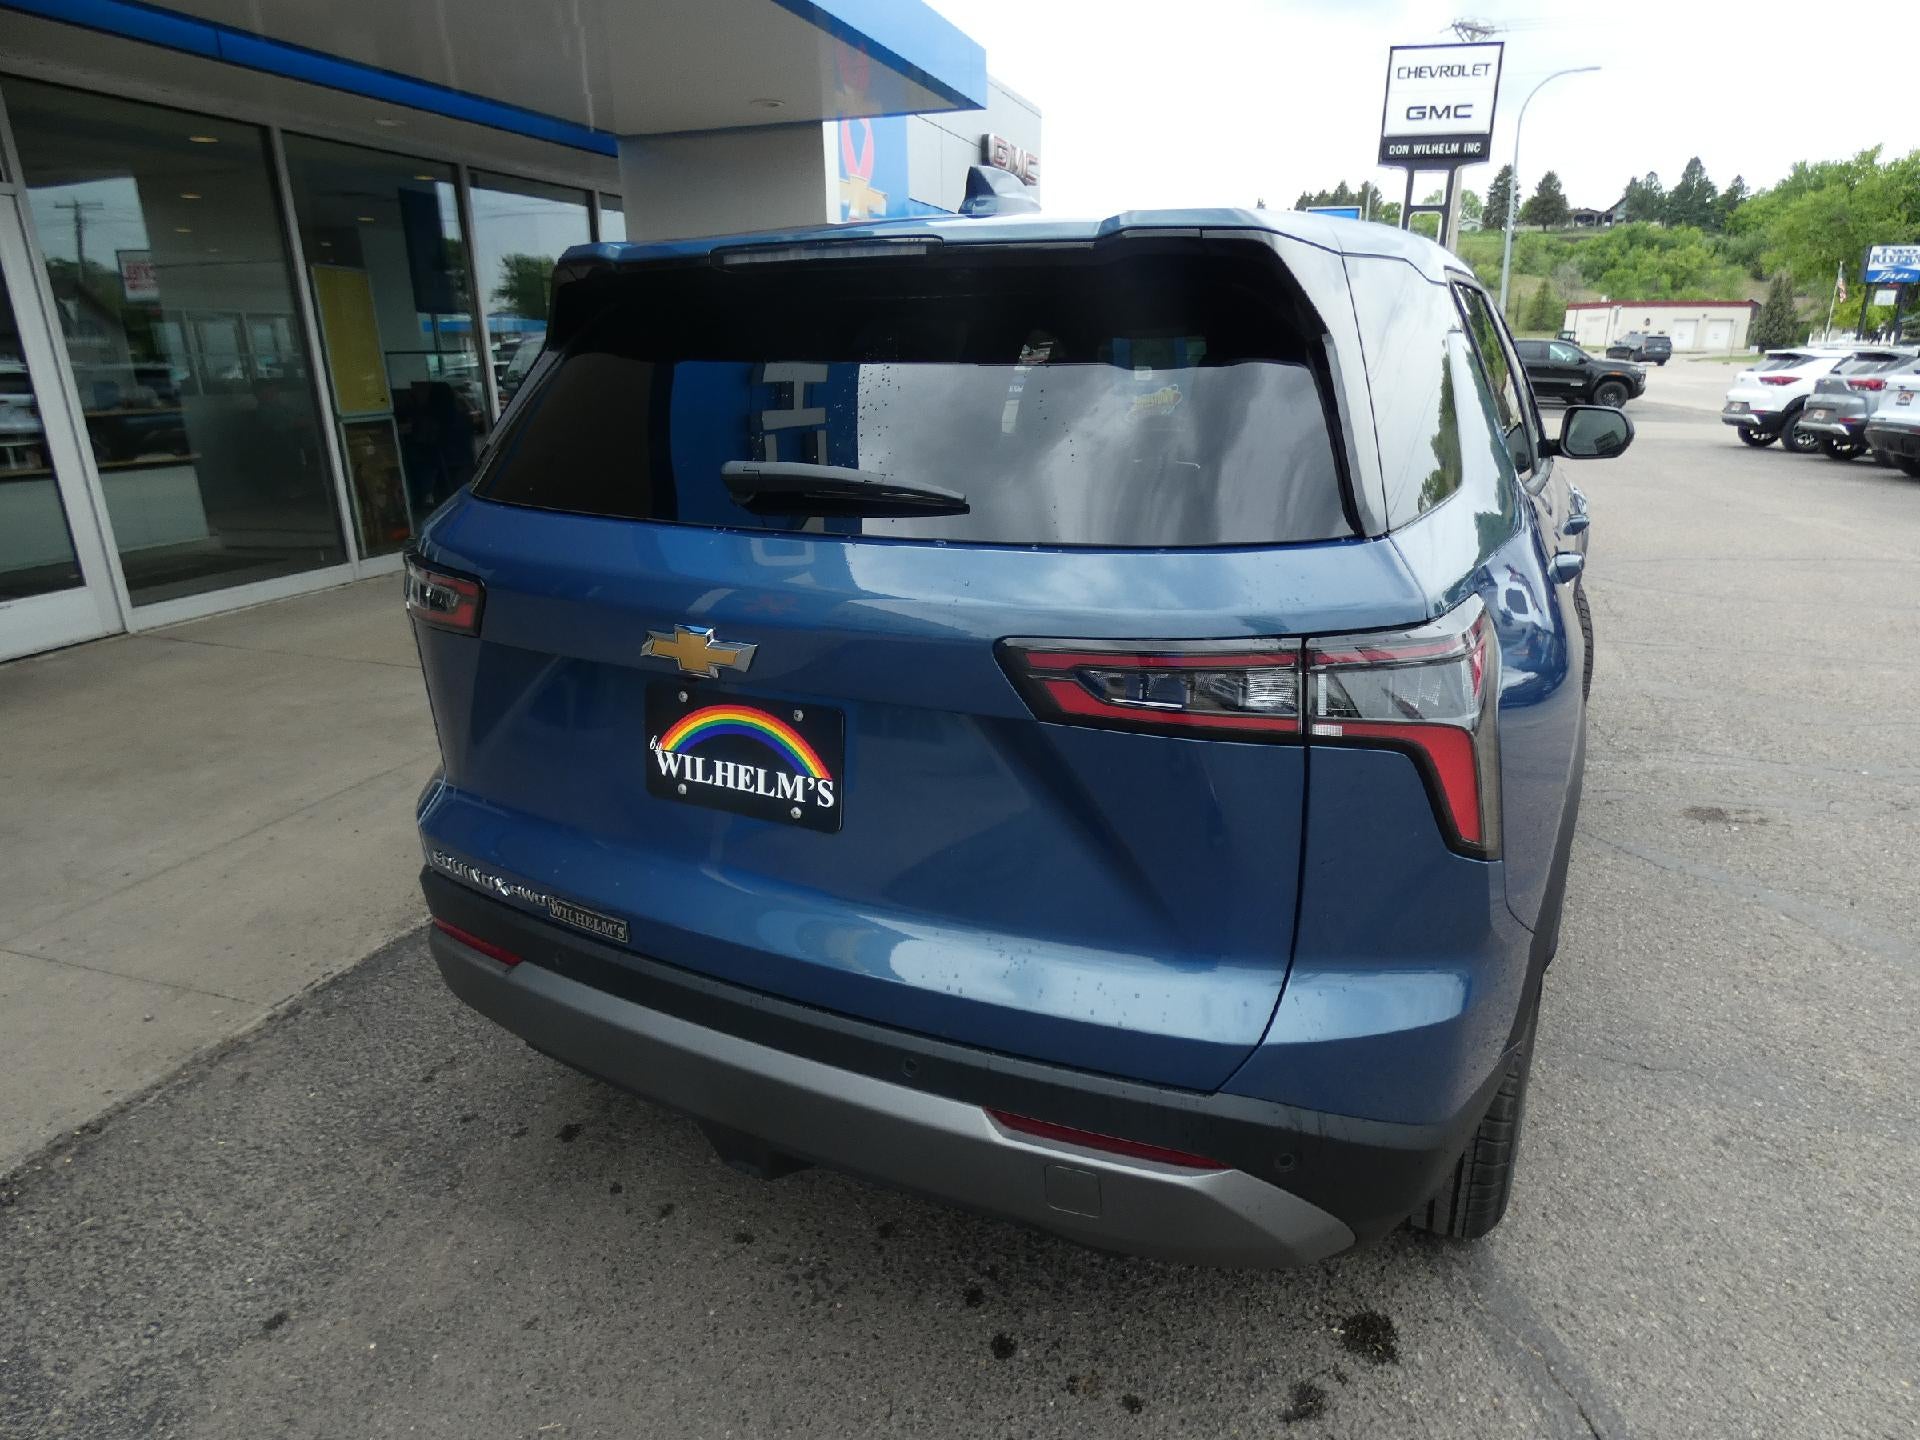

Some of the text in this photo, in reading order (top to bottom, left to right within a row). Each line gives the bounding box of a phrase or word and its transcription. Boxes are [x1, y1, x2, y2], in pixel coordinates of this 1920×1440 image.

[1397, 63, 1491, 79] CHEVROLET
[1406, 104, 1473, 120] GMC
[988, 132, 1039, 186] GMC
[1389, 142, 1481, 155] DON WILHELM INC
[654, 749, 835, 808] WILHELM'S
[550, 902, 626, 939] WILHELM'S
